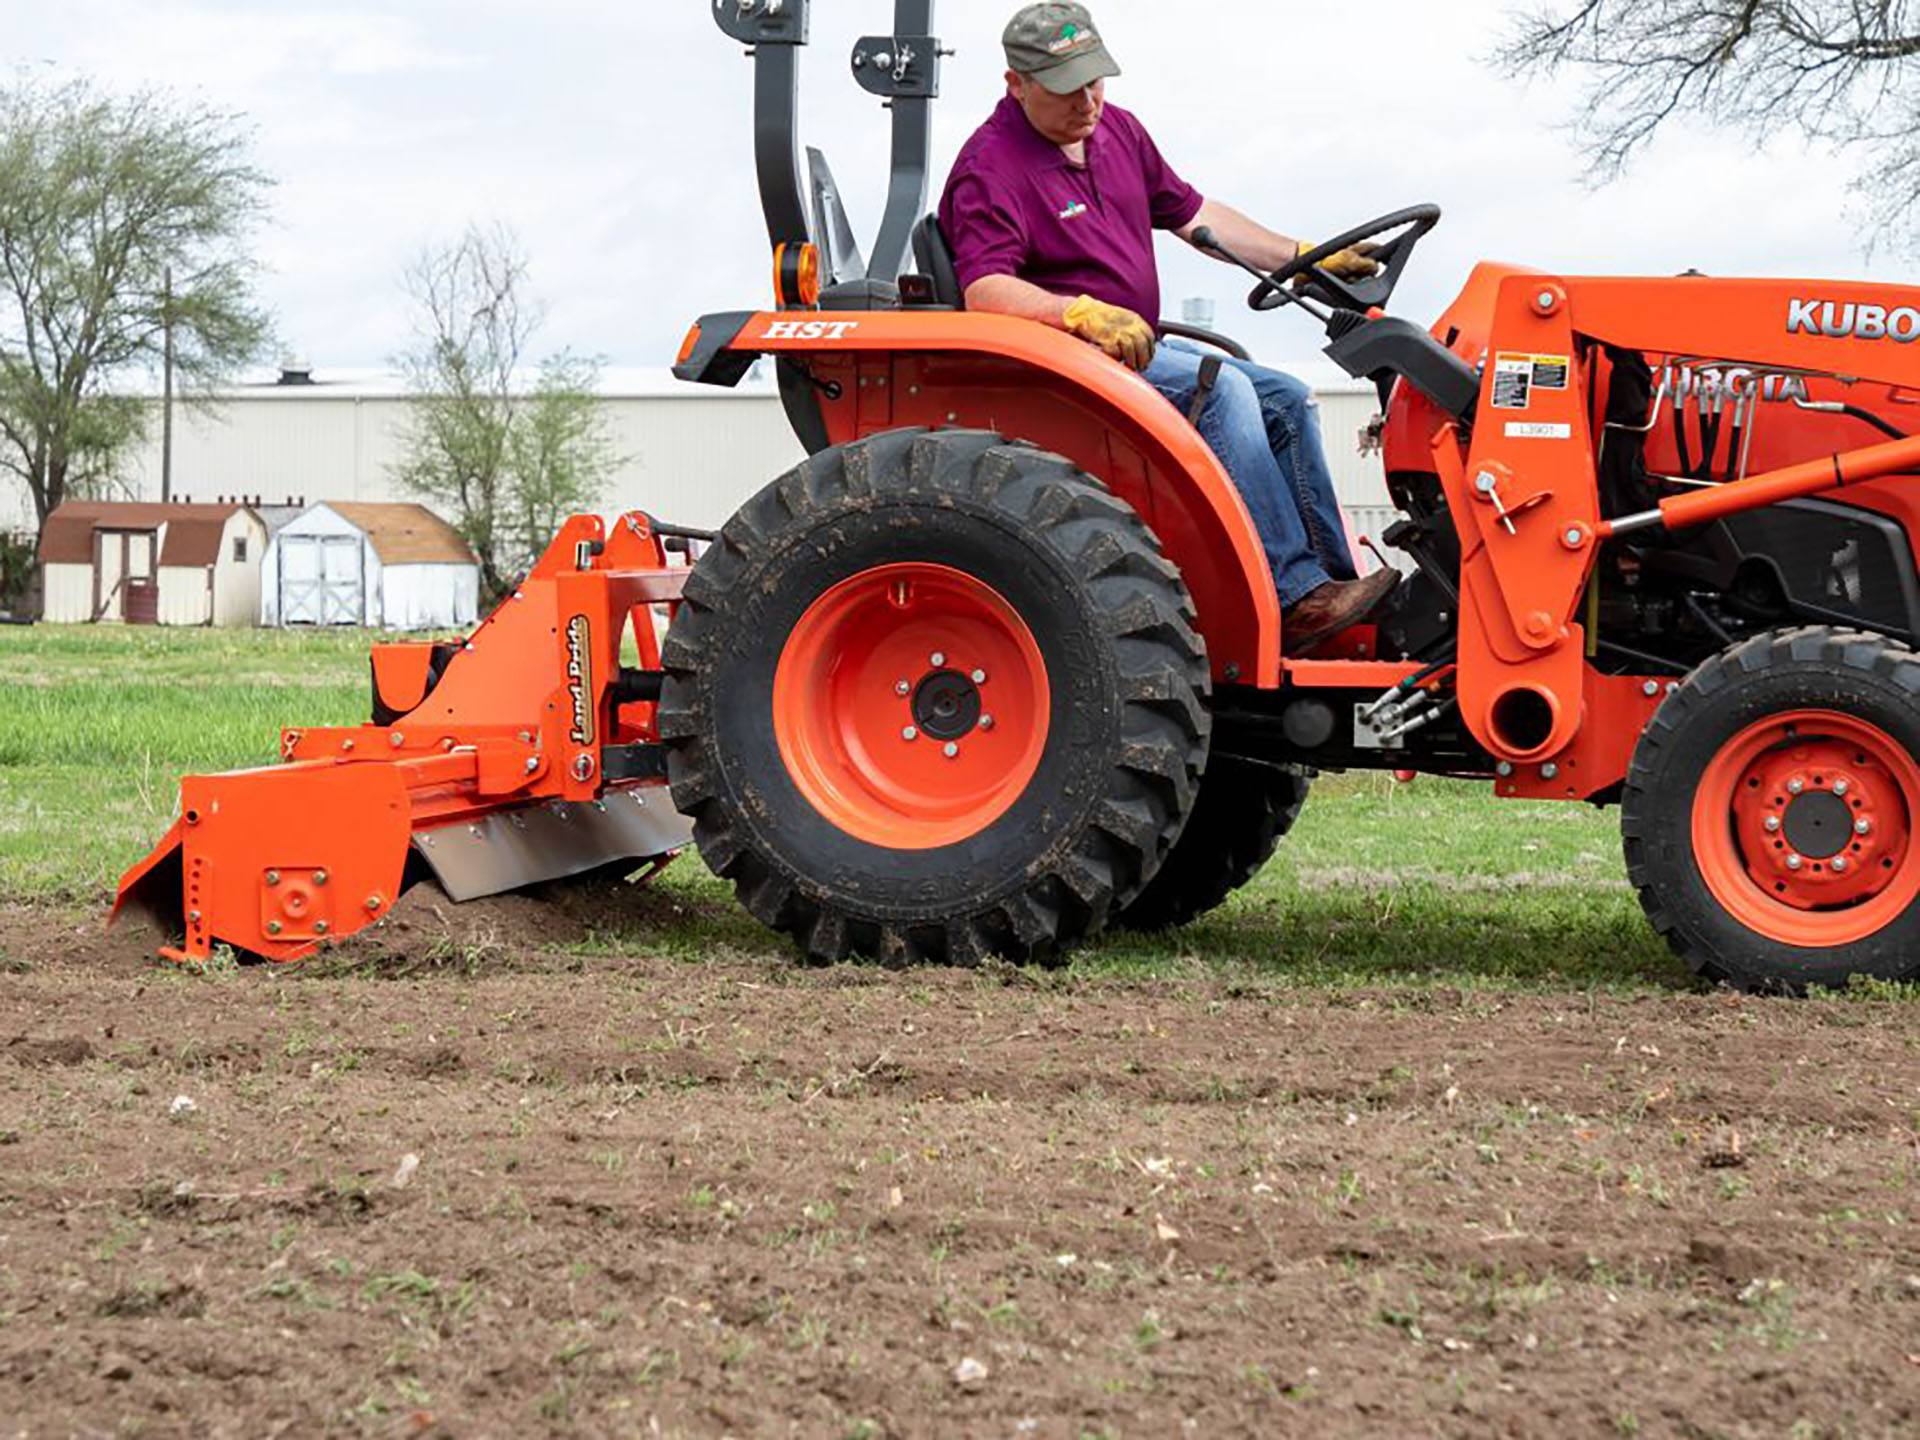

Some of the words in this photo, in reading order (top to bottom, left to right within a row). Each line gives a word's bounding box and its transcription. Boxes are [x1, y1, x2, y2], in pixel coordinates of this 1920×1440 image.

[760, 321, 860, 339] HST
[1786, 298, 1920, 343] KUBO
[567, 618, 582, 676] Pride
[569, 686, 585, 740] Land
